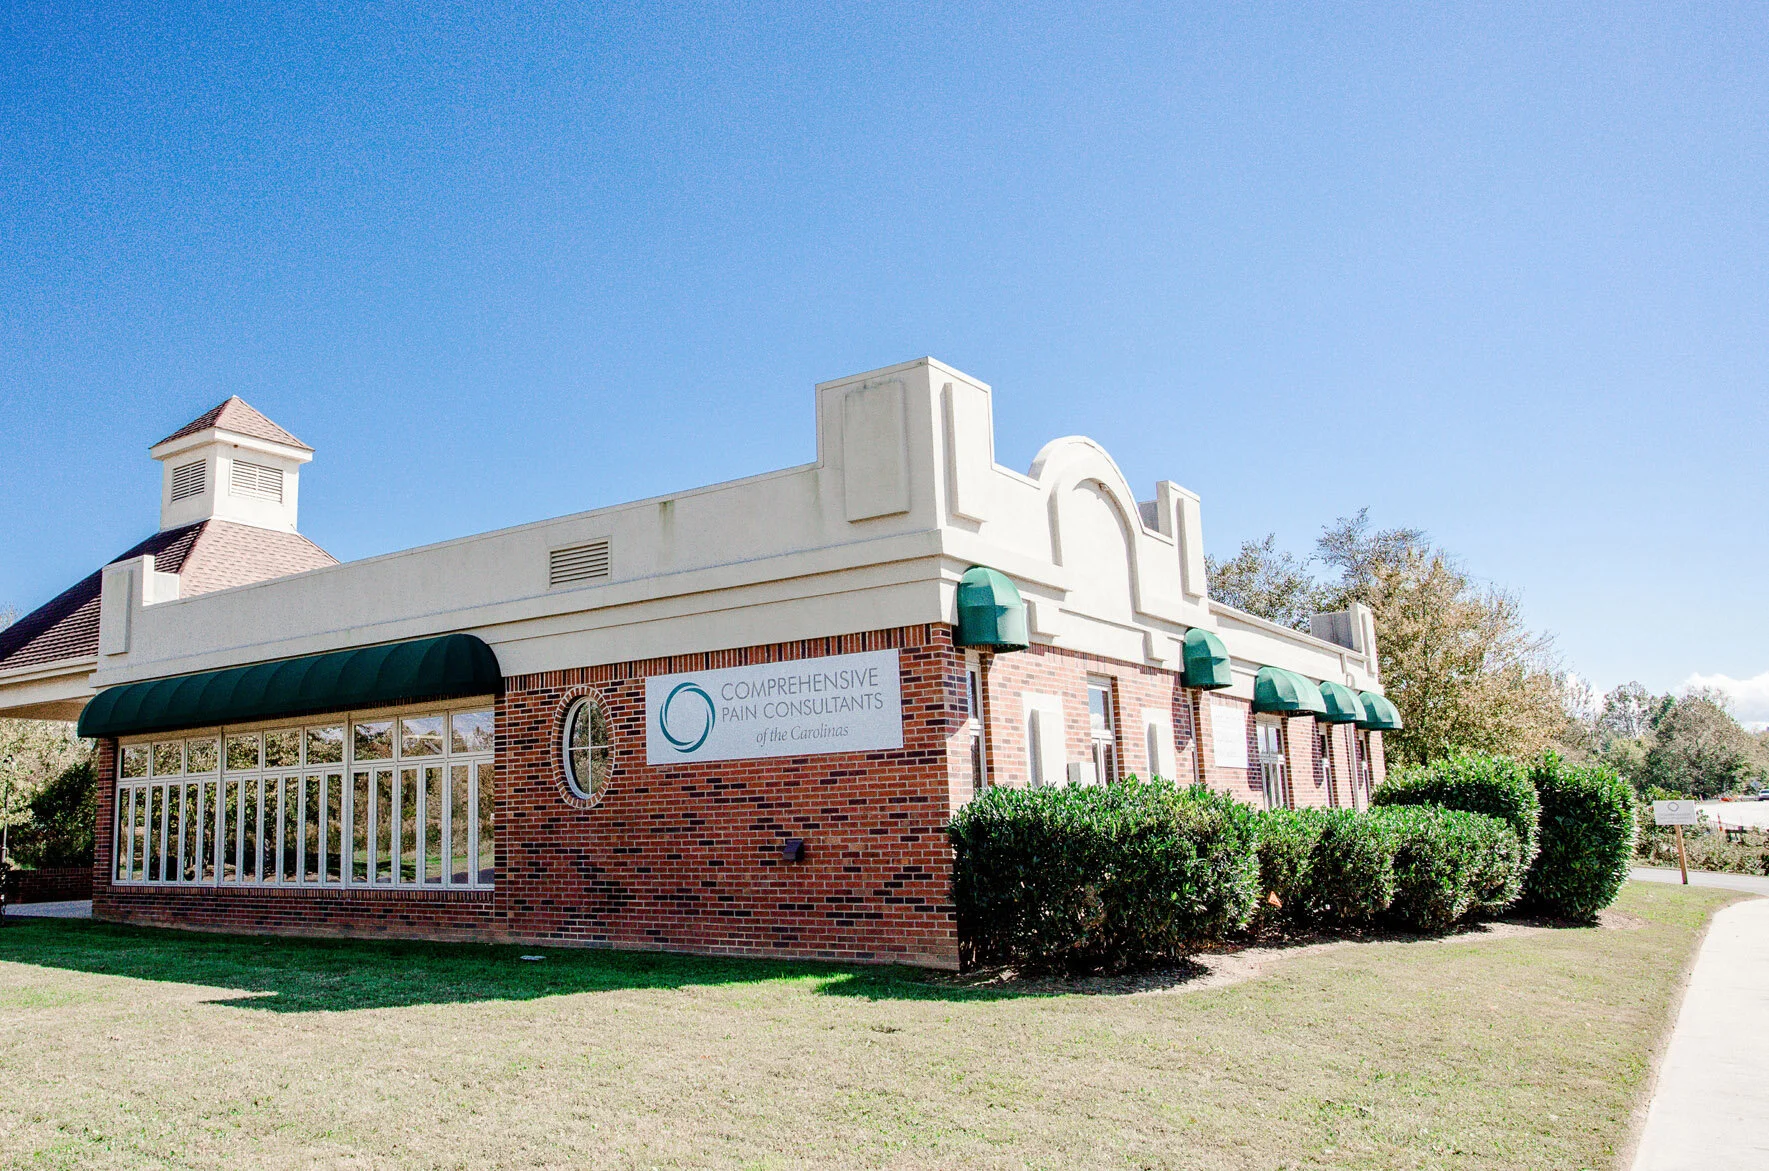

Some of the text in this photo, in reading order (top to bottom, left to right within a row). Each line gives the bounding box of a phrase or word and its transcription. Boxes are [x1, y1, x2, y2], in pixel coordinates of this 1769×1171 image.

[721, 668, 878, 700] COMPREHENSIVE
[722, 693, 882, 722] PAIN CONSULTANTS
[756, 723, 849, 747] of the Carolinas
